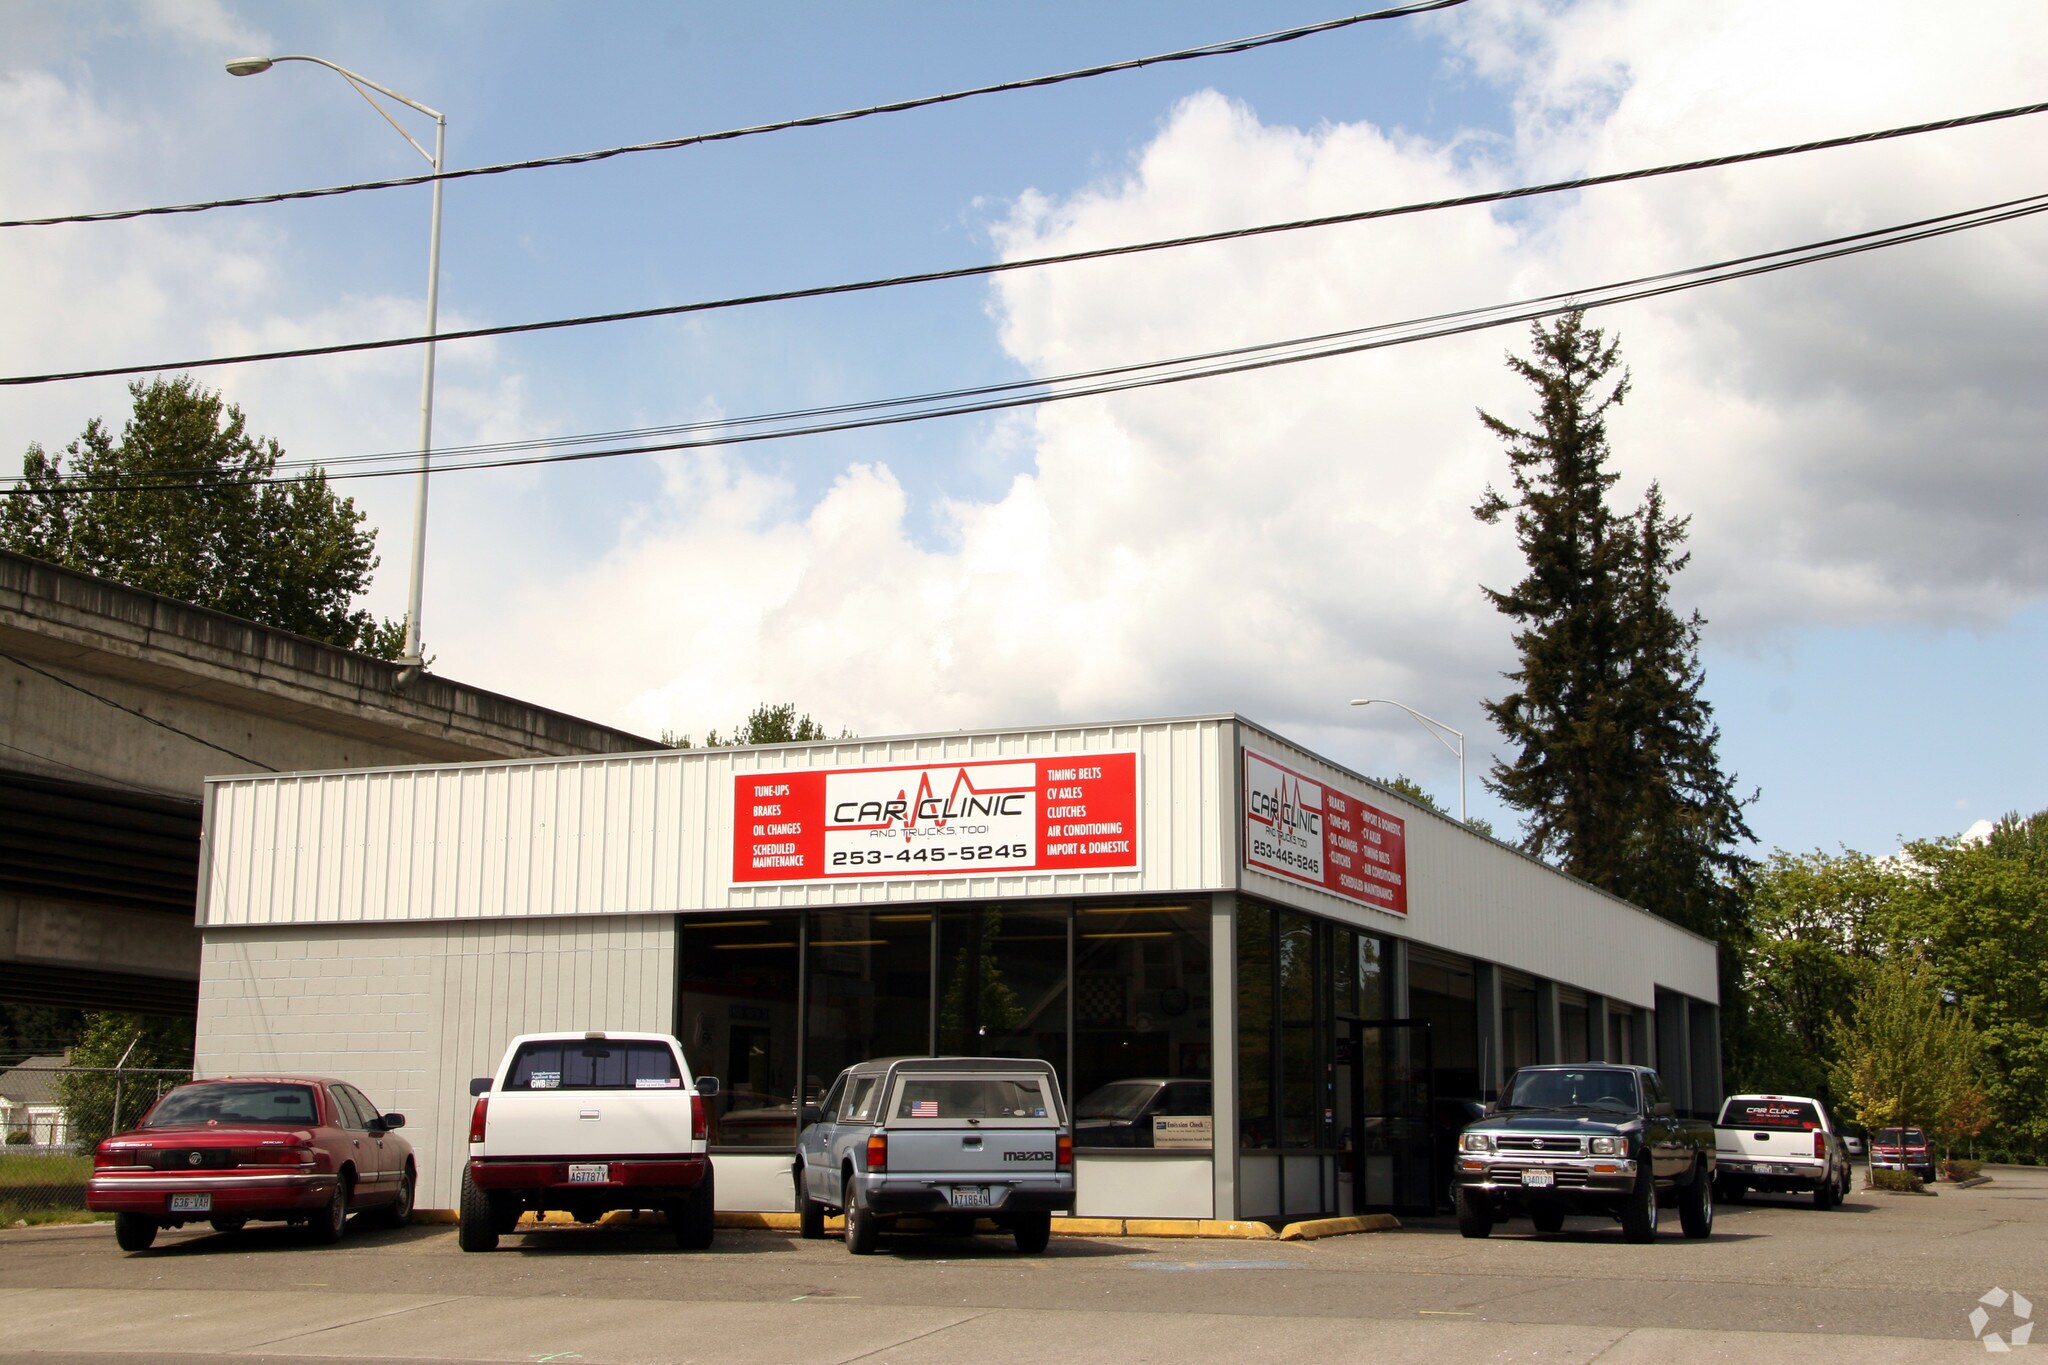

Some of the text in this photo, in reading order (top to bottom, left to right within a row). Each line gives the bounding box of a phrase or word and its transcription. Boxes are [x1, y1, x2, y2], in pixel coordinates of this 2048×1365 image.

[1047, 766, 1102, 781] TIMING BELTS
[754, 784, 790, 797] TUNE-UPS
[1047, 786, 1083, 800] CV AXLES
[753, 804, 782, 817] BRAKES
[833, 795, 1026, 822] CAR CLINIC
[1047, 805, 1087, 818] CLUTCHES
[1251, 790, 1319, 836] CAR CLINIC
[753, 822, 801, 836] OIL CHANGES
[870, 829, 897, 838] AND
[961, 825, 989, 834] TOO!
[1047, 822, 1122, 837] AIR CONDITIONING
[752, 843, 796, 856] SCHEDULED
[832, 844, 1027, 865] 253-445-5245
[1047, 840, 1130, 856] IMPORT & DOMESTIC
[752, 855, 804, 868] MAINTENANCE
[1253, 839, 1319, 874] 253-445-5245
[530, 1079, 546, 1088] GWB
[570, 1171, 606, 1182] A67787Y
[173, 1198, 209, 1208] 636-VAH
[954, 1194, 988, 1206] A71864N
